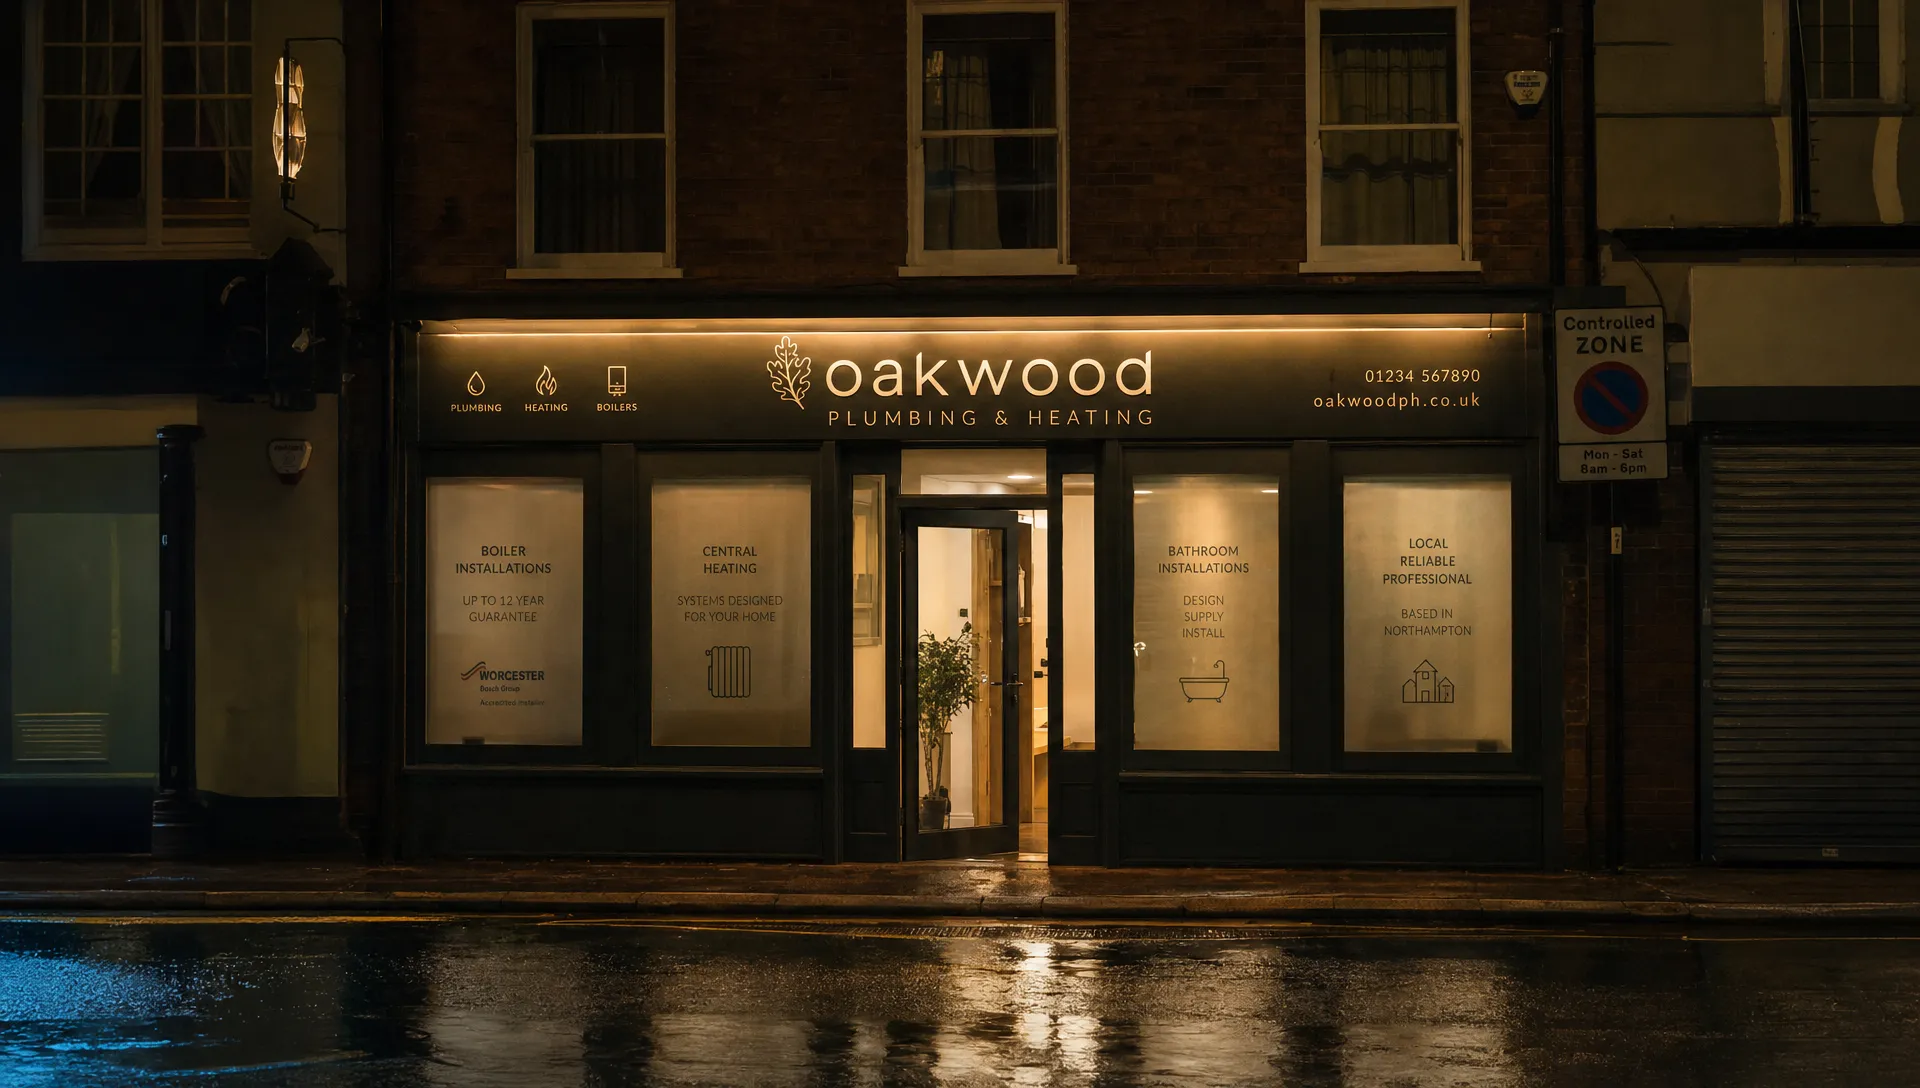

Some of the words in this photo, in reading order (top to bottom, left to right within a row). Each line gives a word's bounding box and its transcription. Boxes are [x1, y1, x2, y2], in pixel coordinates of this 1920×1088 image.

[1564, 315, 1655, 331] Controlled
[1576, 335, 1643, 354] ZONE
[826, 350, 1152, 397] oakwood
[1365, 369, 1414, 383] 01234
[1421, 369, 1480, 383] 567890
[1313, 392, 1480, 410] oakwoodph.co.uk
[450, 403, 502, 413] PLUMBING
[524, 403, 568, 412] HEATING
[596, 403, 638, 412] BOILERS
[828, 410, 977, 427] PLUMBING
[994, 409, 1009, 426] &
[1028, 409, 1153, 426] HEATING
[1584, 450, 1609, 460] Mon
[1622, 449, 1643, 459] Sat
[1581, 464, 1608, 474] 8am
[1620, 463, 1647, 475] 6pm
[1409, 538, 1448, 549] LOCAL
[481, 546, 526, 557] BOILER
[702, 546, 757, 557] CENTRAL
[1168, 546, 1239, 557] BATHROOM
[1400, 556, 1456, 567] RELIABLE
[456, 563, 552, 574] INSTALLATIONS
[703, 563, 757, 574] HEATING
[1158, 563, 1249, 574] INSTALLATIONS
[1383, 574, 1472, 585] PROFESSIONAL
[462, 596, 478, 606] UP
[480, 596, 497, 606] TO
[500, 596, 513, 606] 12
[516, 596, 544, 606] YEAR
[677, 596, 725, 606] SYSTEMS
[728, 596, 783, 606] DESIGNED
[1183, 595, 1224, 606] DESIGN
[469, 612, 537, 622] GUARANTEE
[684, 611, 706, 622] FOR
[709, 611, 739, 622] YOUR
[742, 611, 776, 622] HOME
[1184, 611, 1224, 622] SUPPLY
[1401, 608, 1438, 619] BASED
[1441, 608, 1453, 619] IN
[1182, 628, 1225, 638] INSTALL
[1384, 625, 1472, 636] NORTHAMPTON
[480, 670, 545, 681] WORCESTER
